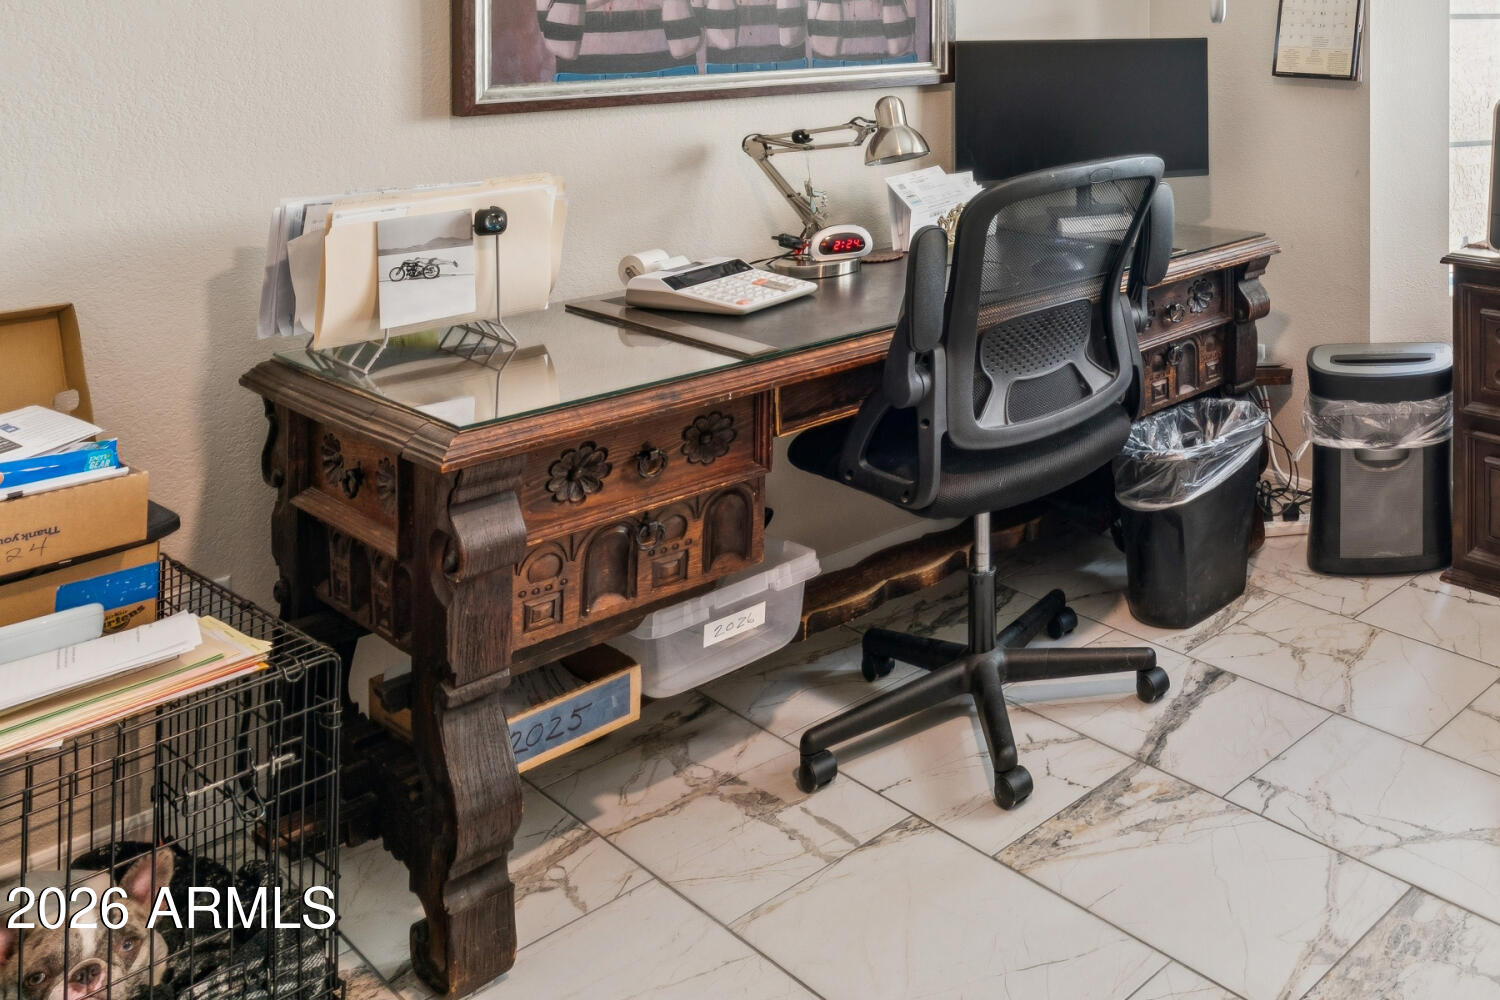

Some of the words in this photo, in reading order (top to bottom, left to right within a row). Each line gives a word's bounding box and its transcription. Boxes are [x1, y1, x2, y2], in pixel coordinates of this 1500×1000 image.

[833, 239, 860, 250] 2:24
[22, 525, 61, 542] Thank
[103, 604, 146, 628] rtens
[510, 702, 593, 754] 2025
